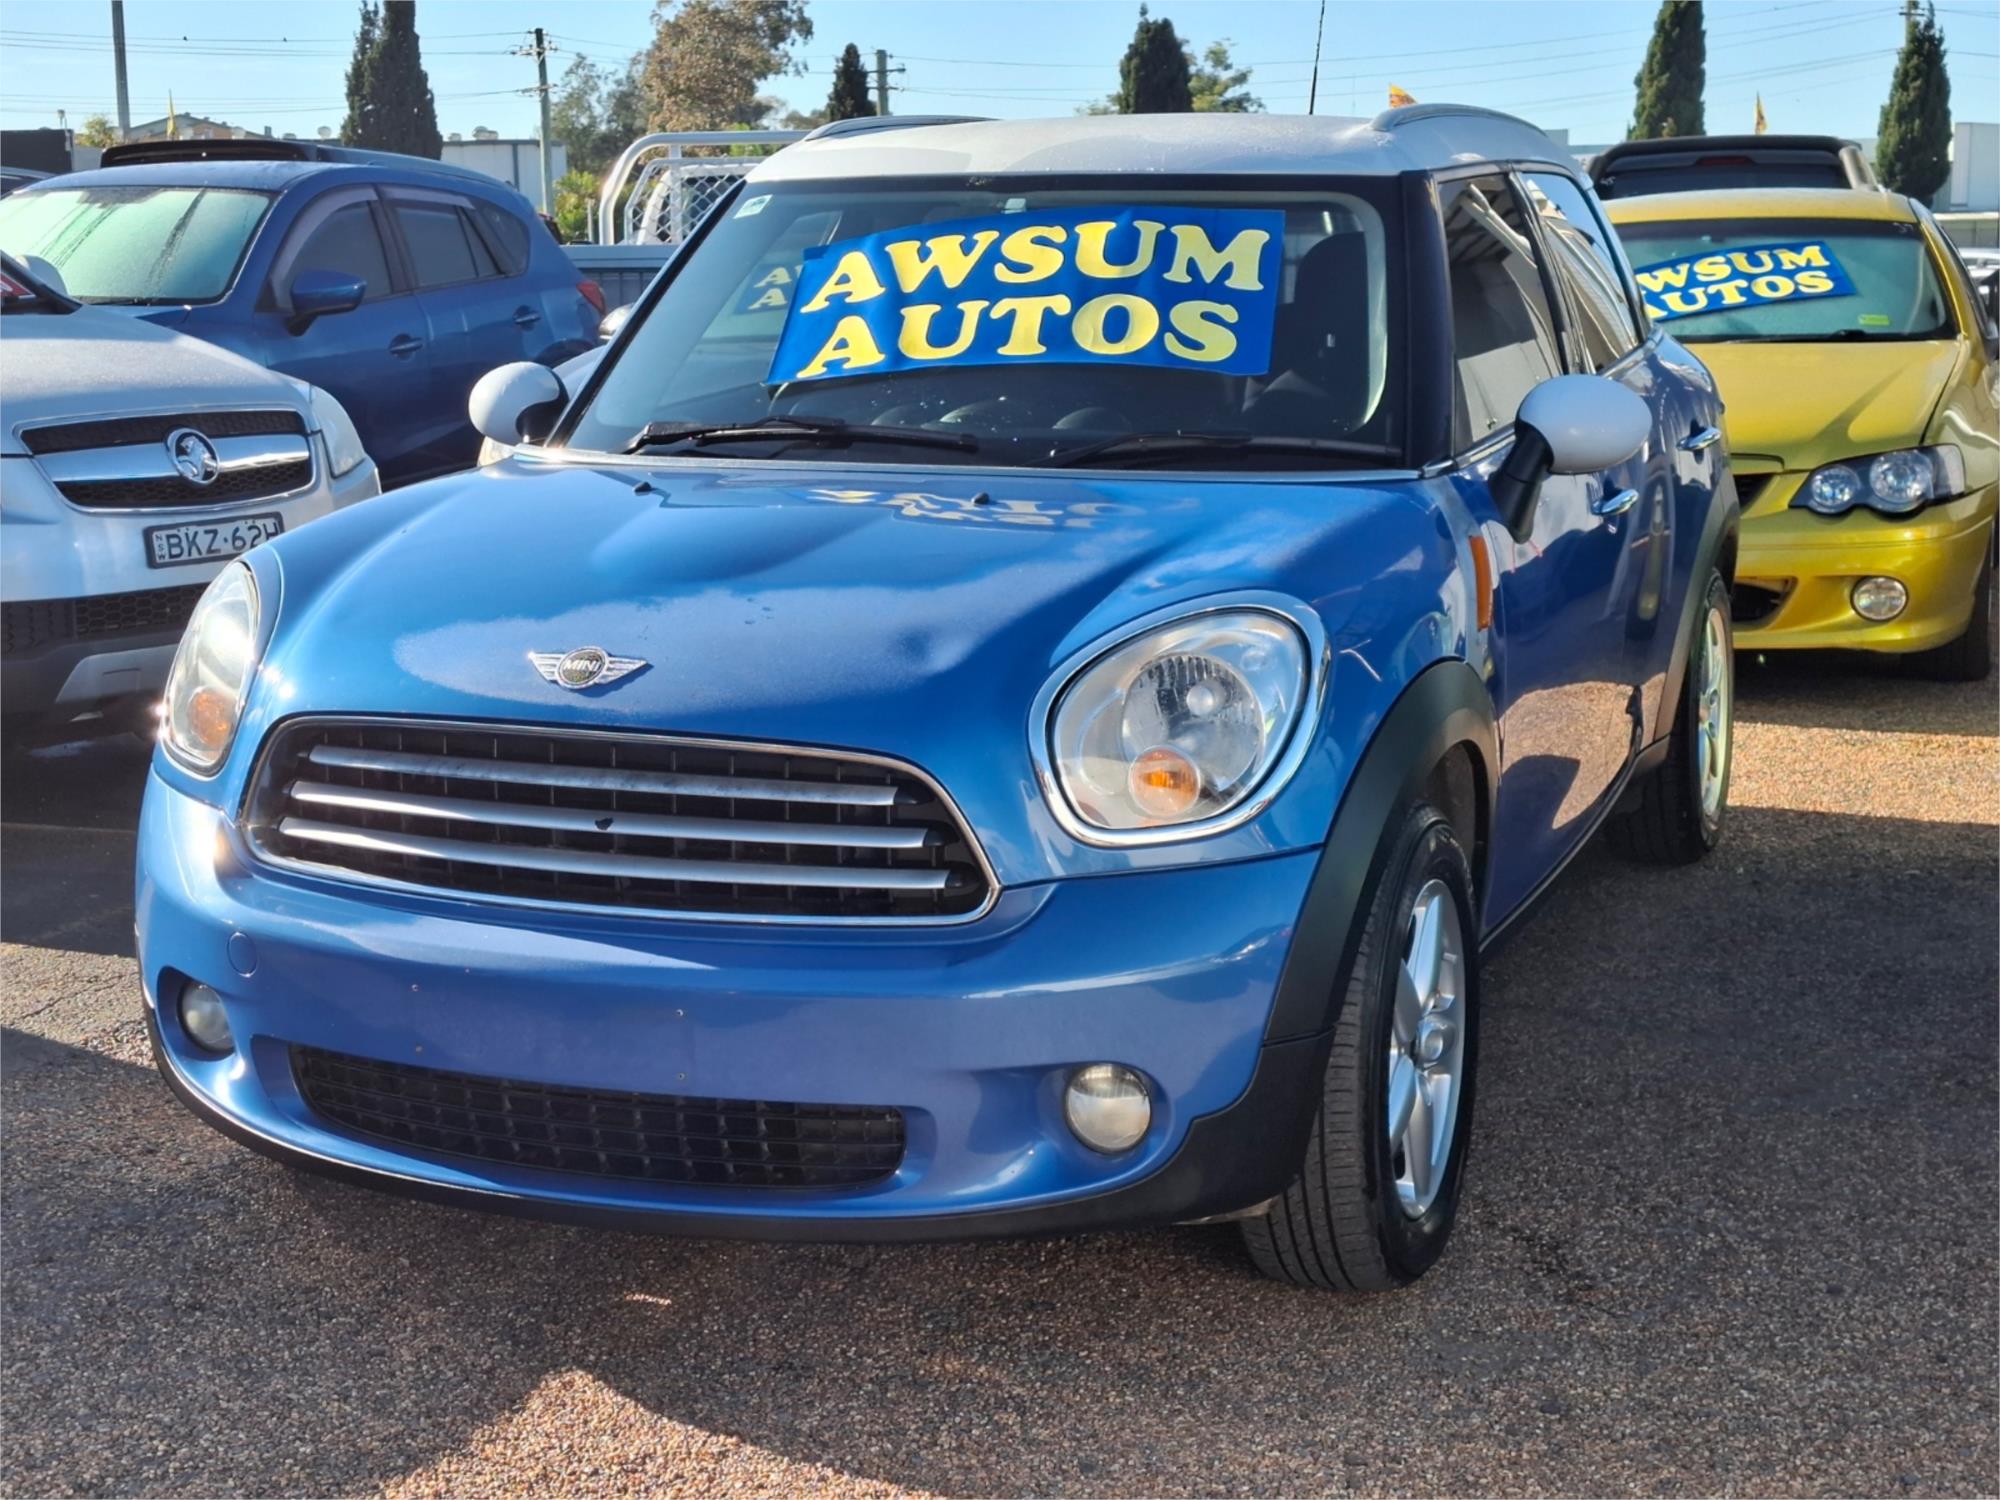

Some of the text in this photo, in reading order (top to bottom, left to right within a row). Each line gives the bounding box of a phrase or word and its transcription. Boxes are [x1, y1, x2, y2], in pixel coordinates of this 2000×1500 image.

[801, 220, 1270, 313] AWSUM
[1635, 245, 1830, 293] WSUM
[797, 293, 1239, 378] AUTOS
[563, 659, 601, 671] MINI
